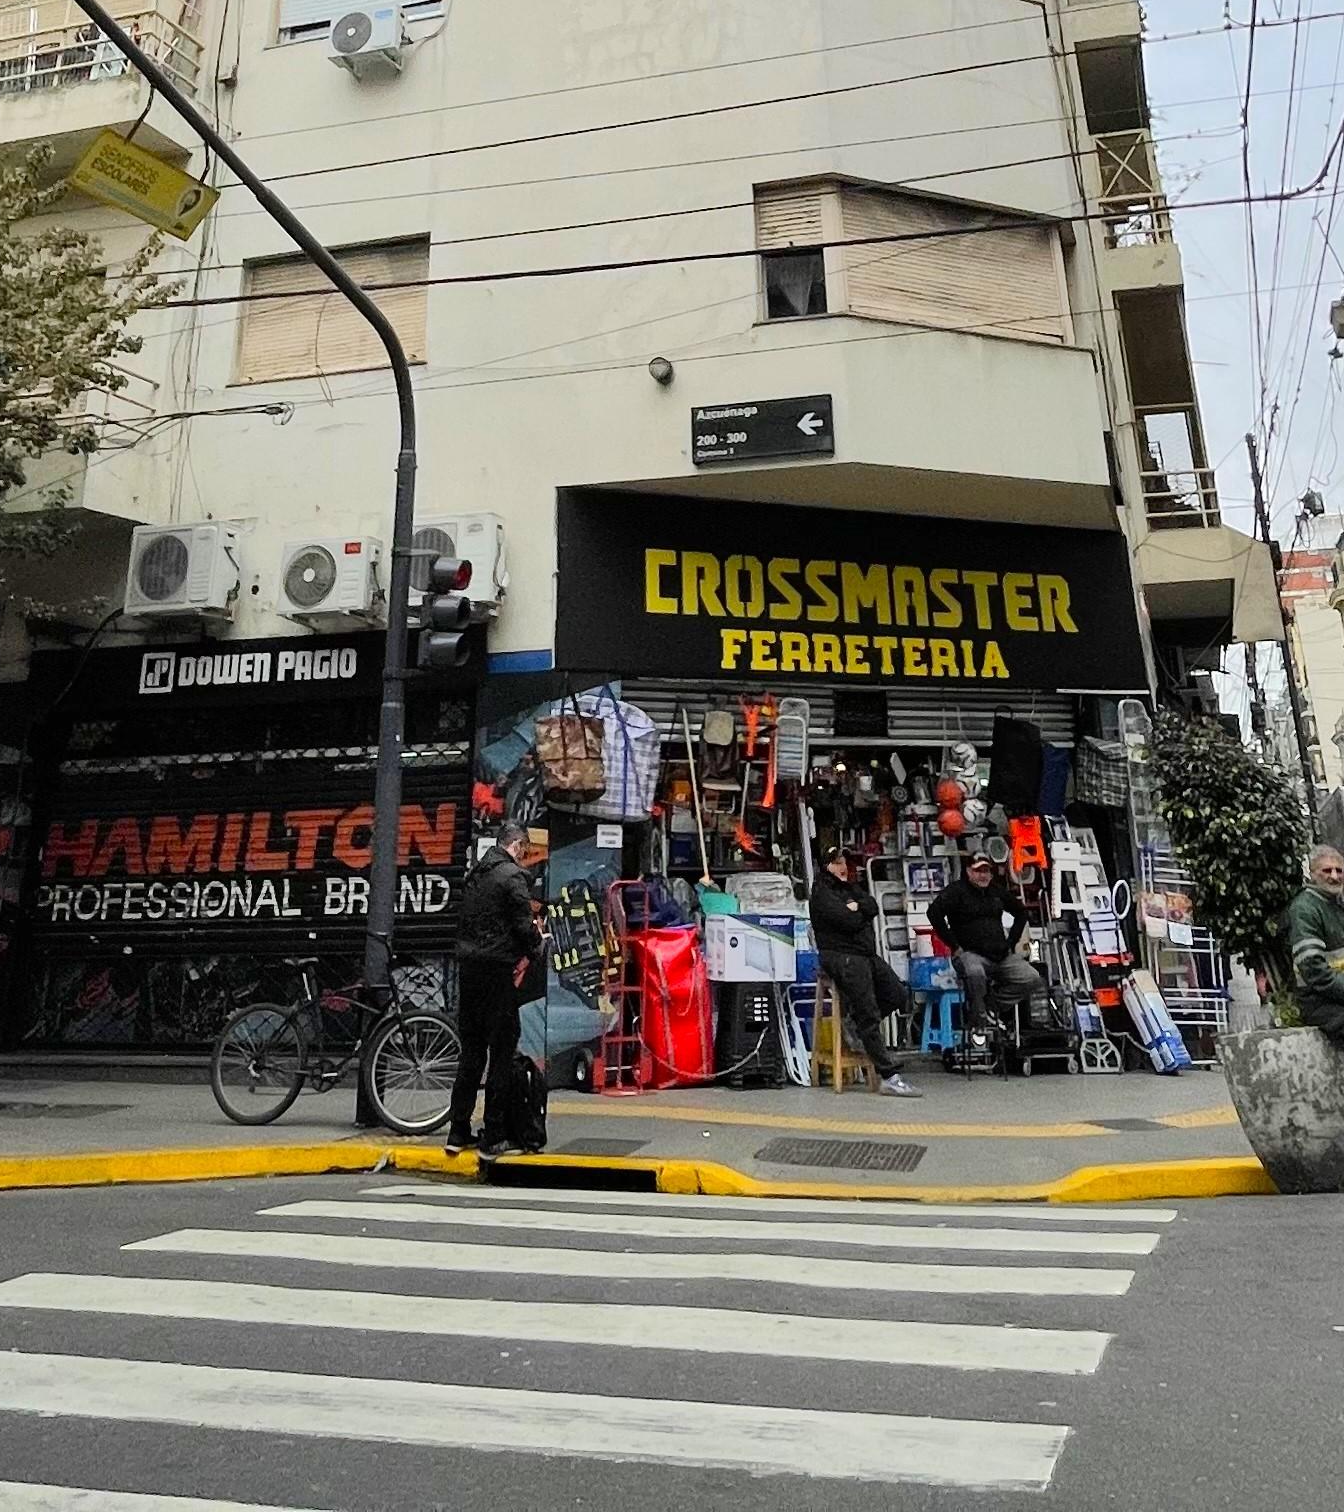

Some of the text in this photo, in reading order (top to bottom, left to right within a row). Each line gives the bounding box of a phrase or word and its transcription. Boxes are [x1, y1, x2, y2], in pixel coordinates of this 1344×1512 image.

[697, 434, 718, 446] 200
[726, 432, 748, 444] 300
[644, 548, 1080, 633] CROSSMASTER
[178, 652, 272, 687] DOWEN
[277, 648, 357, 681] PAGIO
[720, 627, 1011, 679] FERRETERIA
[42, 802, 458, 878] HAMILTON
[38, 874, 451, 922] PROFESSIONAL BRND
